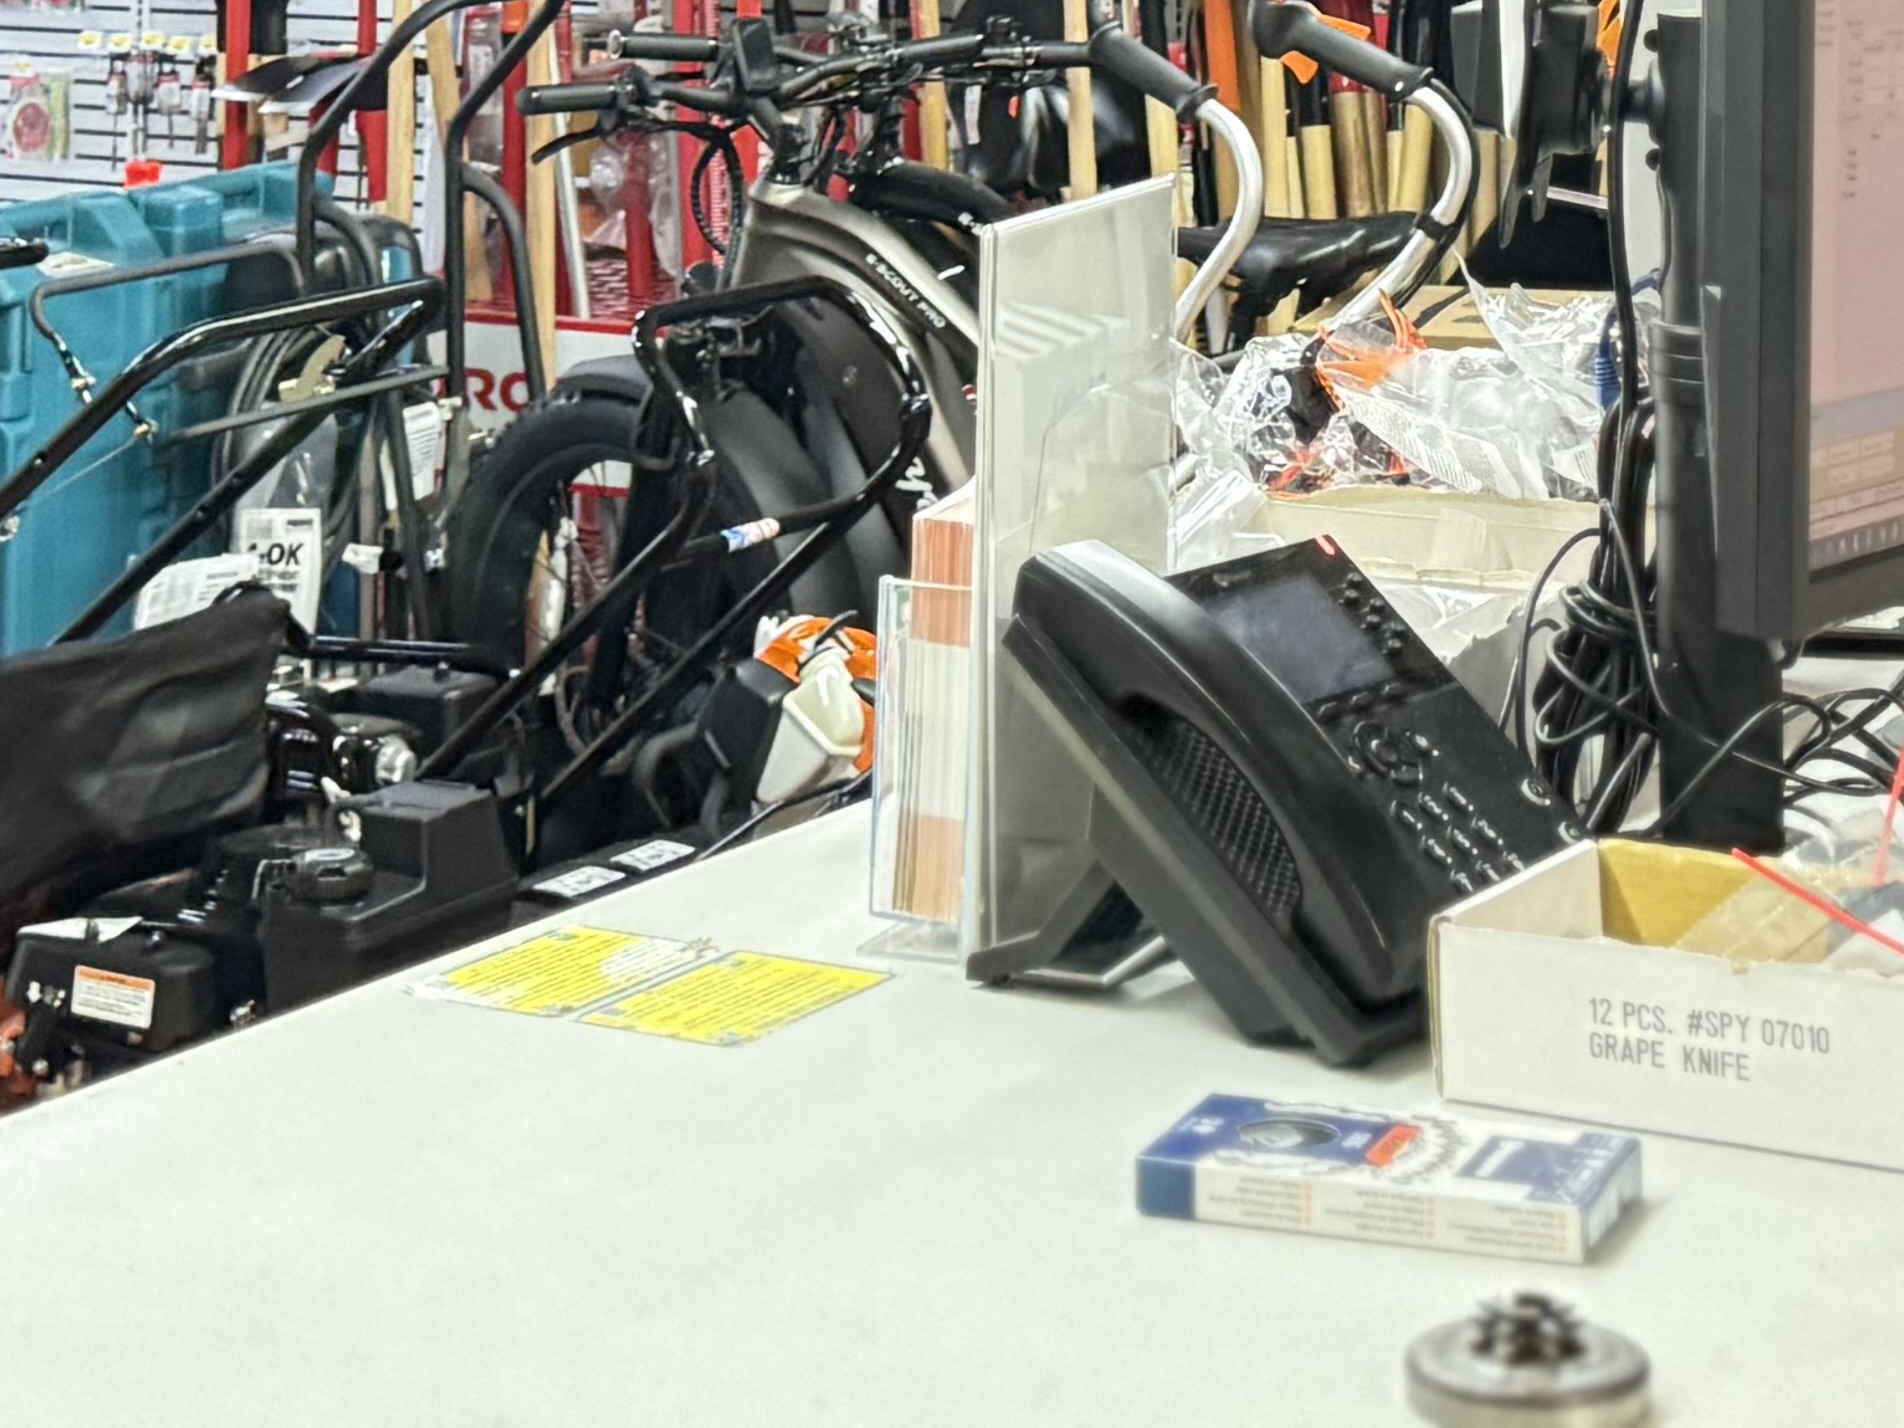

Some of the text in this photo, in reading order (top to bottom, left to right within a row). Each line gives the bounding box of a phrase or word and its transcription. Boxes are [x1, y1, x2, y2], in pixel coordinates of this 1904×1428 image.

[1589, 996, 1831, 1055] 12 PCS. #SPY 07010
[1589, 1031, 1752, 1083] GRAPE KNIFE
